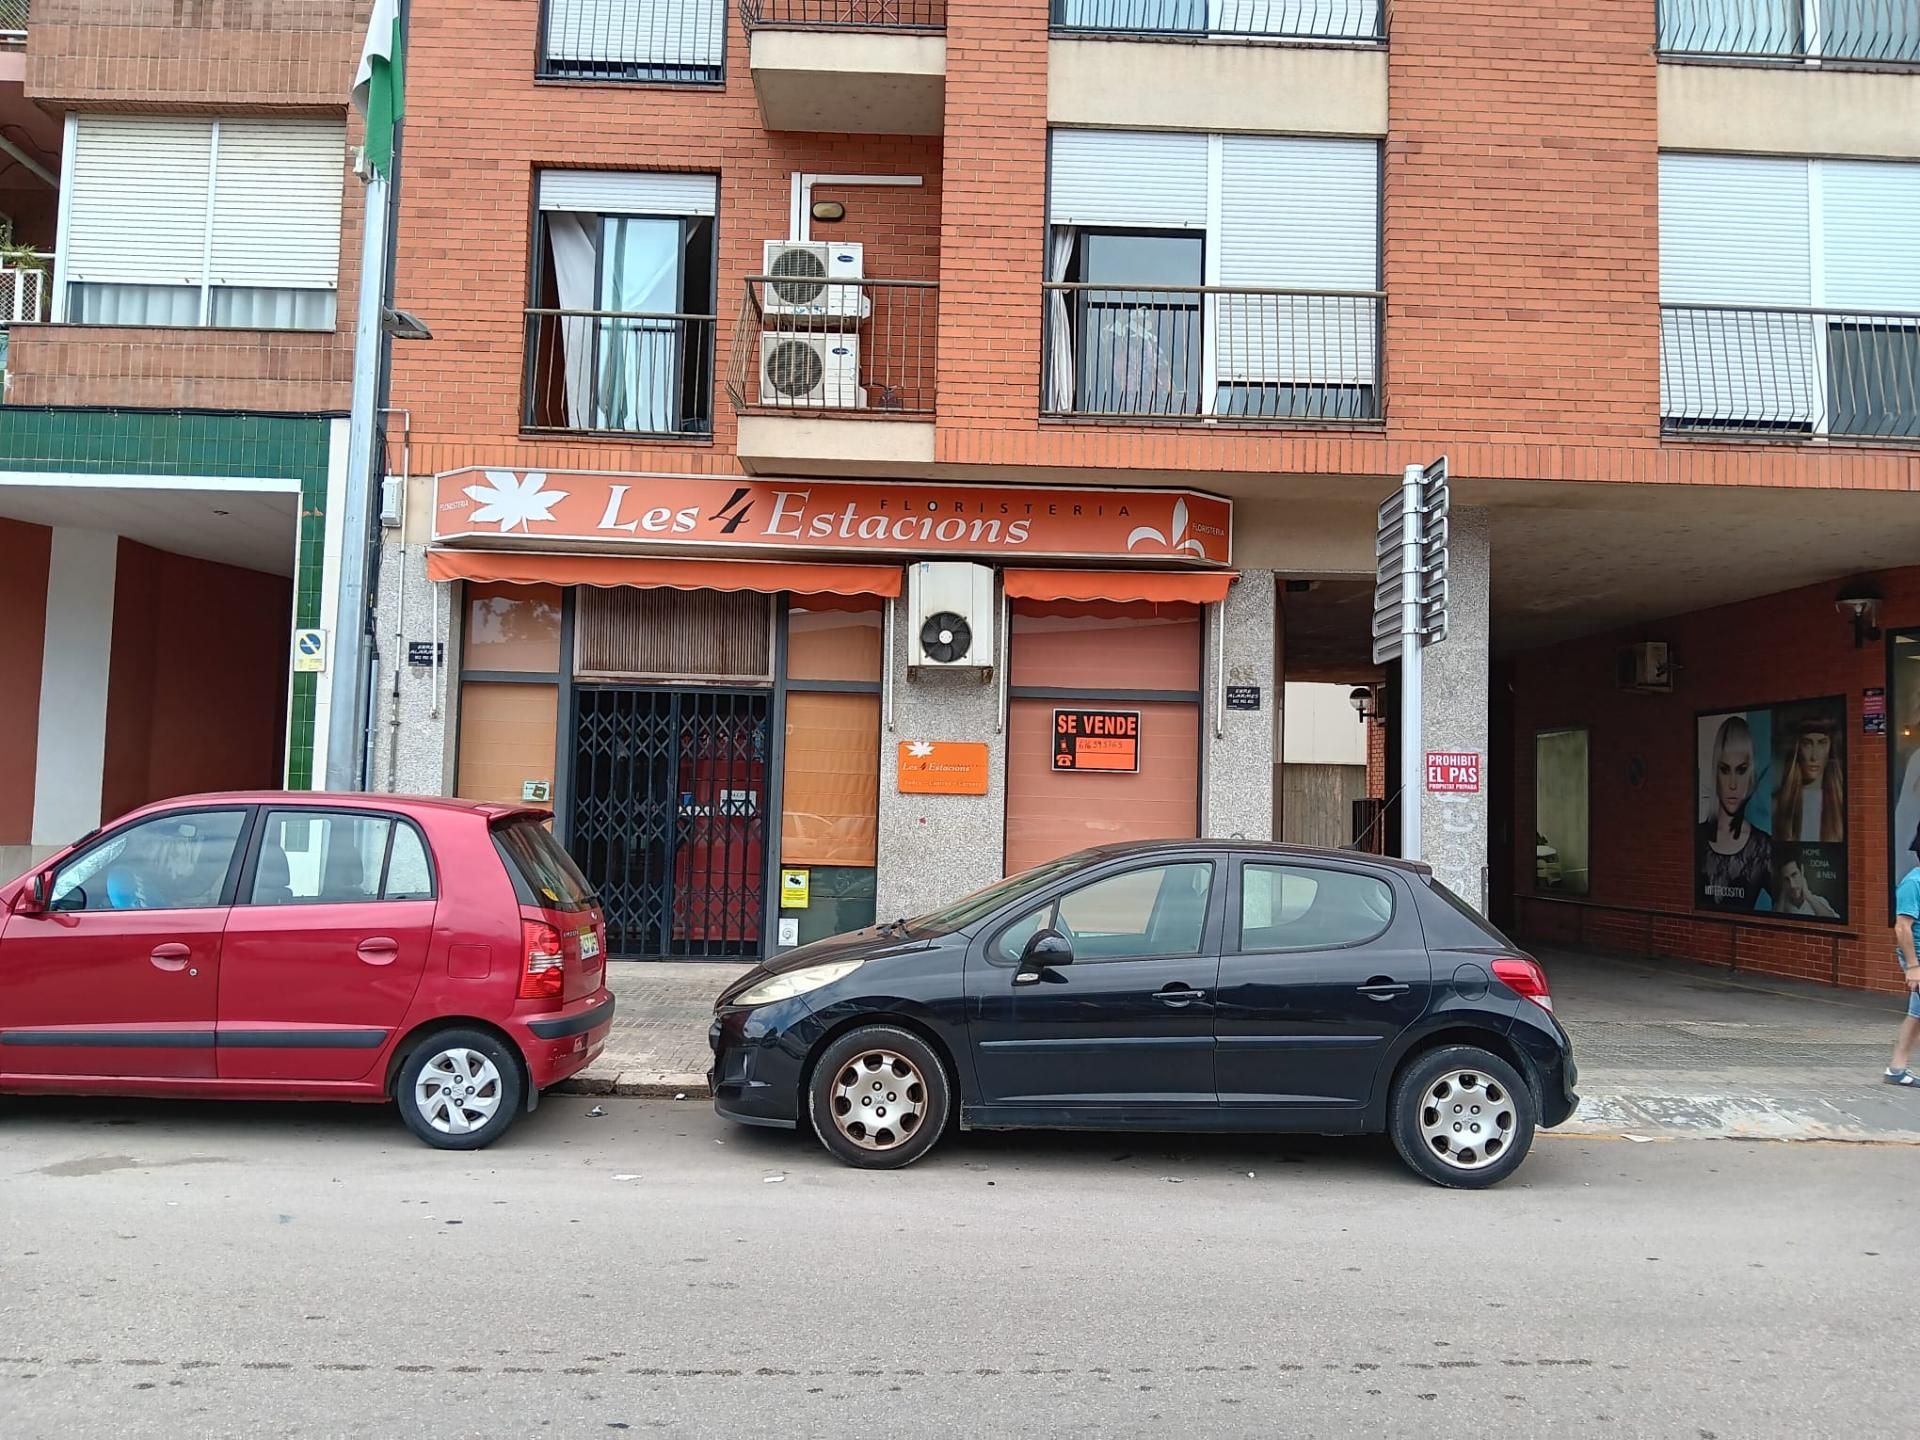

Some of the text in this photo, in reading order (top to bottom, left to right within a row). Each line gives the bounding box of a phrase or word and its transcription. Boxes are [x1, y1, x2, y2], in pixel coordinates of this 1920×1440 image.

[597, 485, 1032, 545] Les 4 Estacions
[880, 499, 1130, 517] FLORISTERIA
[1057, 714, 1137, 736] SE VENDE
[902, 762, 918, 771] Les
[928, 762, 971, 772] Estacions
[1428, 755, 1477, 766] PROHIBIT
[1428, 767, 1478, 783] EL PAS
